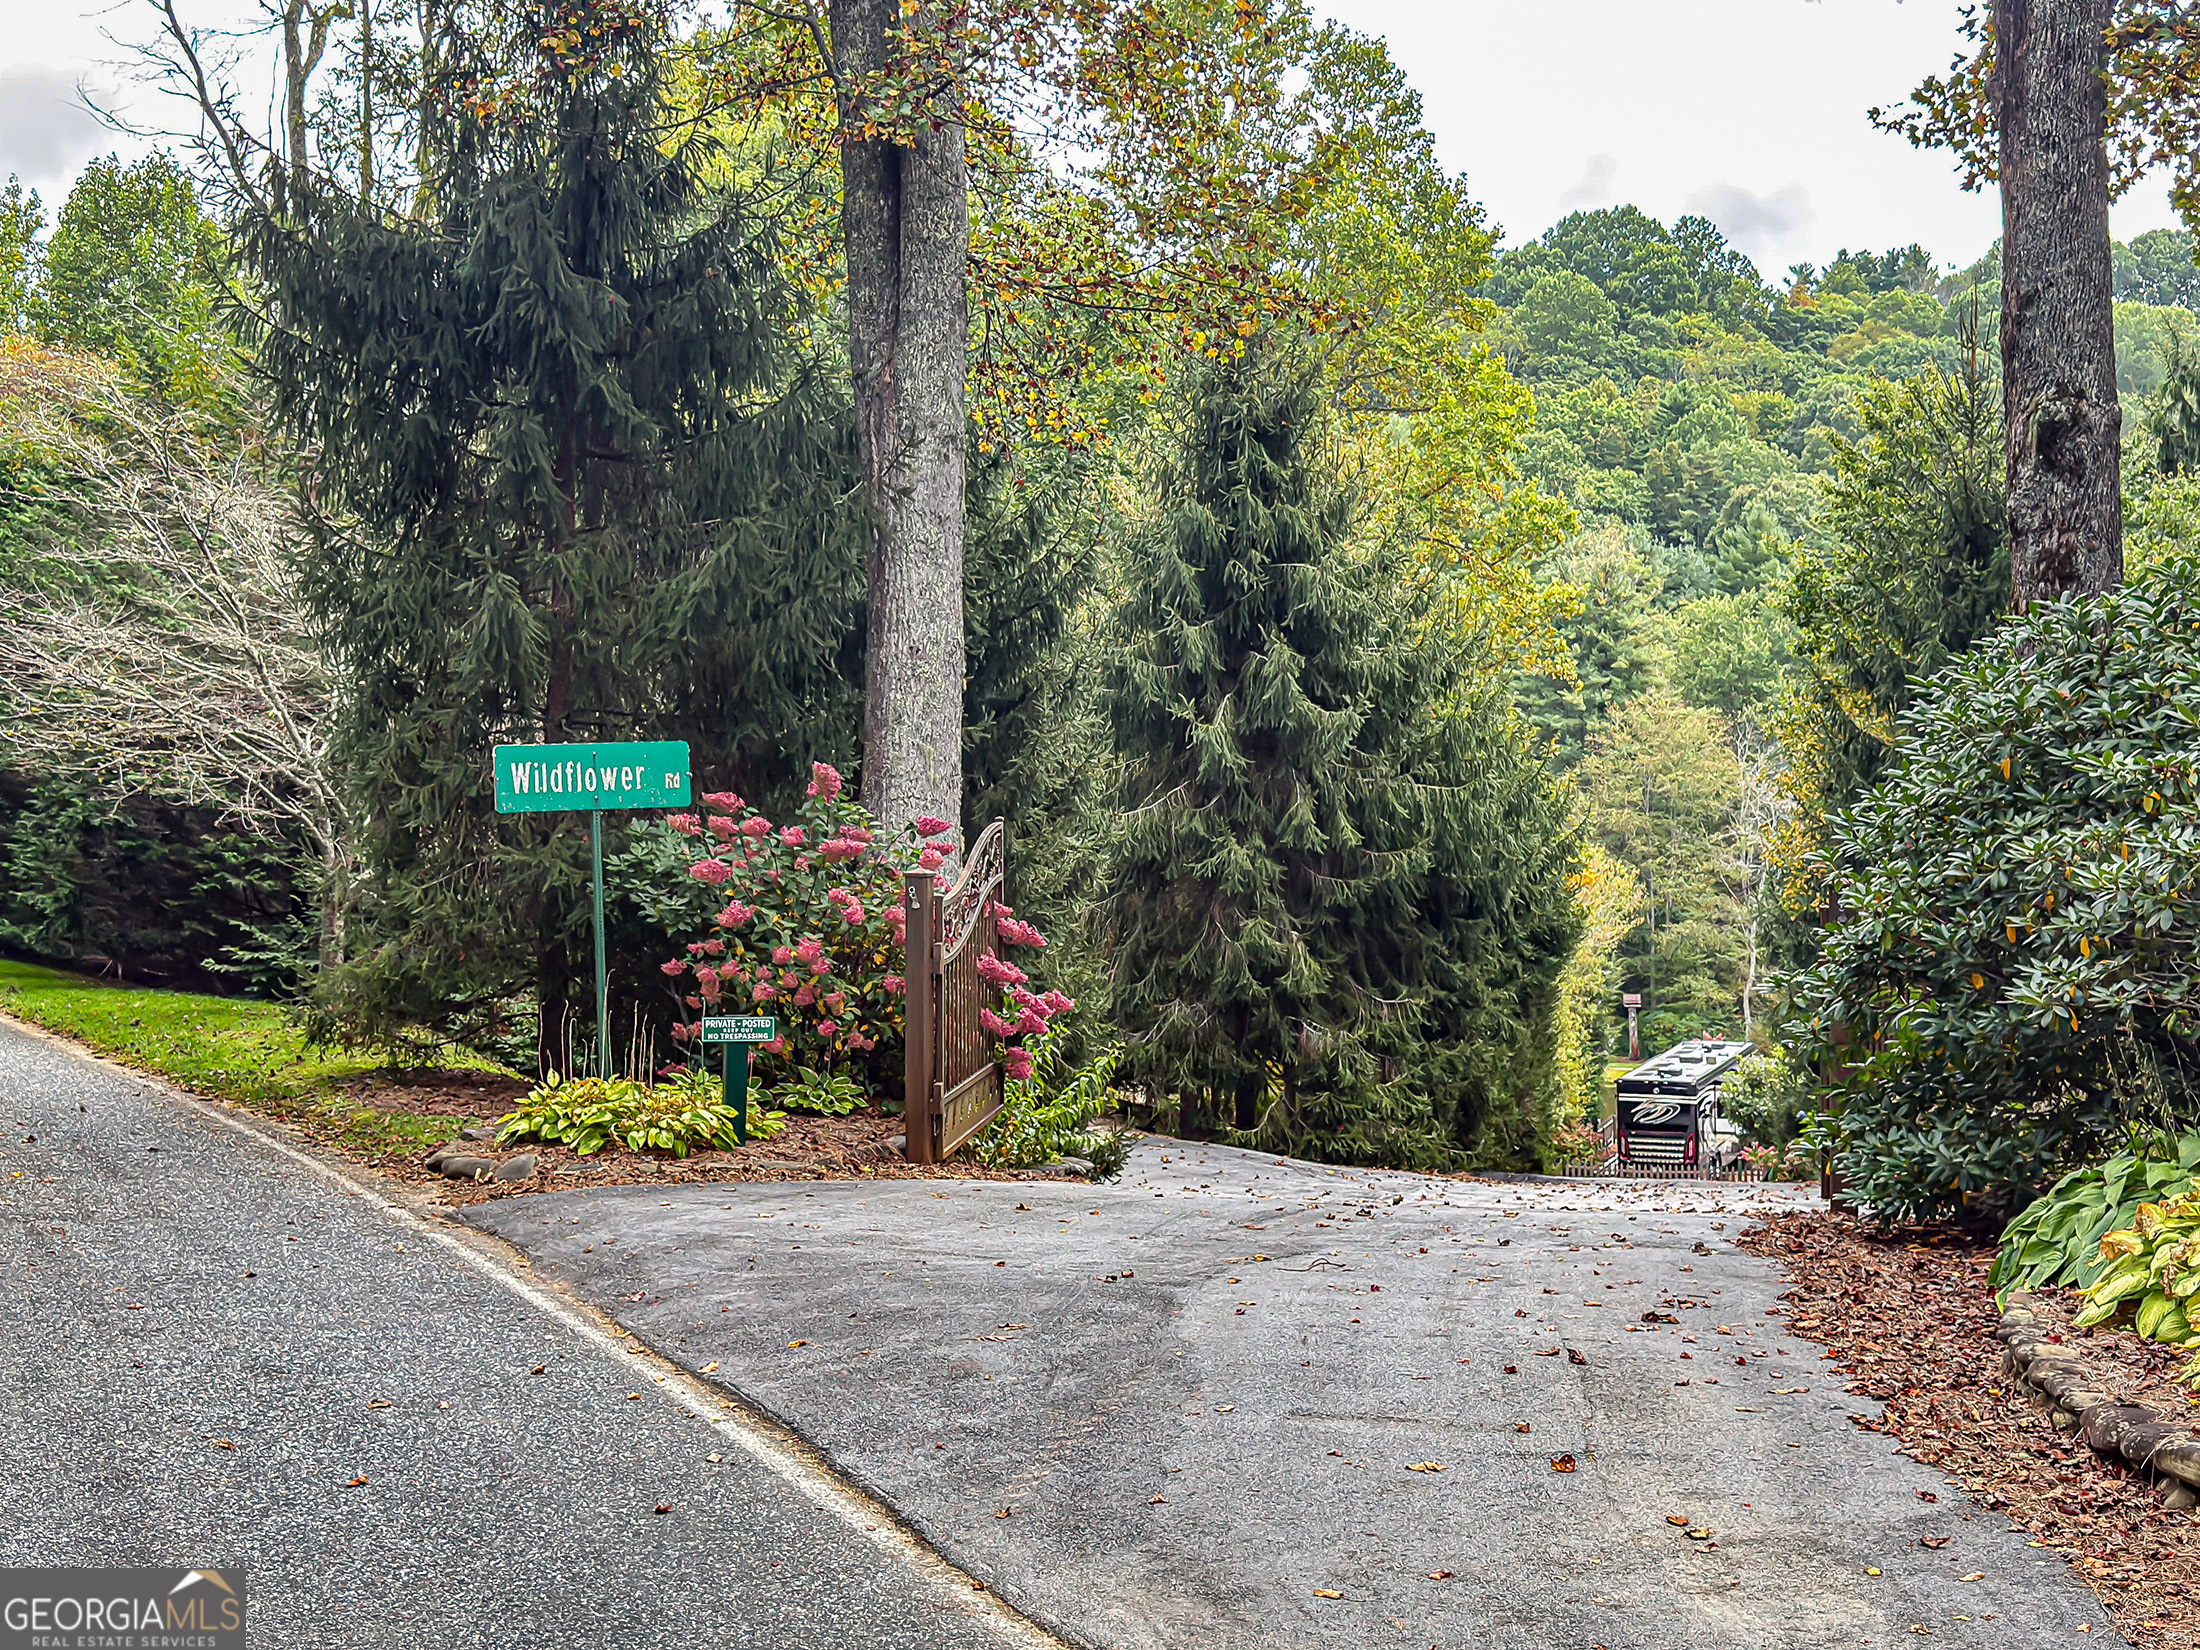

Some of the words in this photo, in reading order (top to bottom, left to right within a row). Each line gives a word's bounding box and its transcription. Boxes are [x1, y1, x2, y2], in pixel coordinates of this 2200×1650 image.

[510, 761, 645, 794] Wildflower
[665, 772, 681, 789] Rd
[705, 1019, 736, 1028] PRIVATE
[742, 1019, 771, 1028] POSTED
